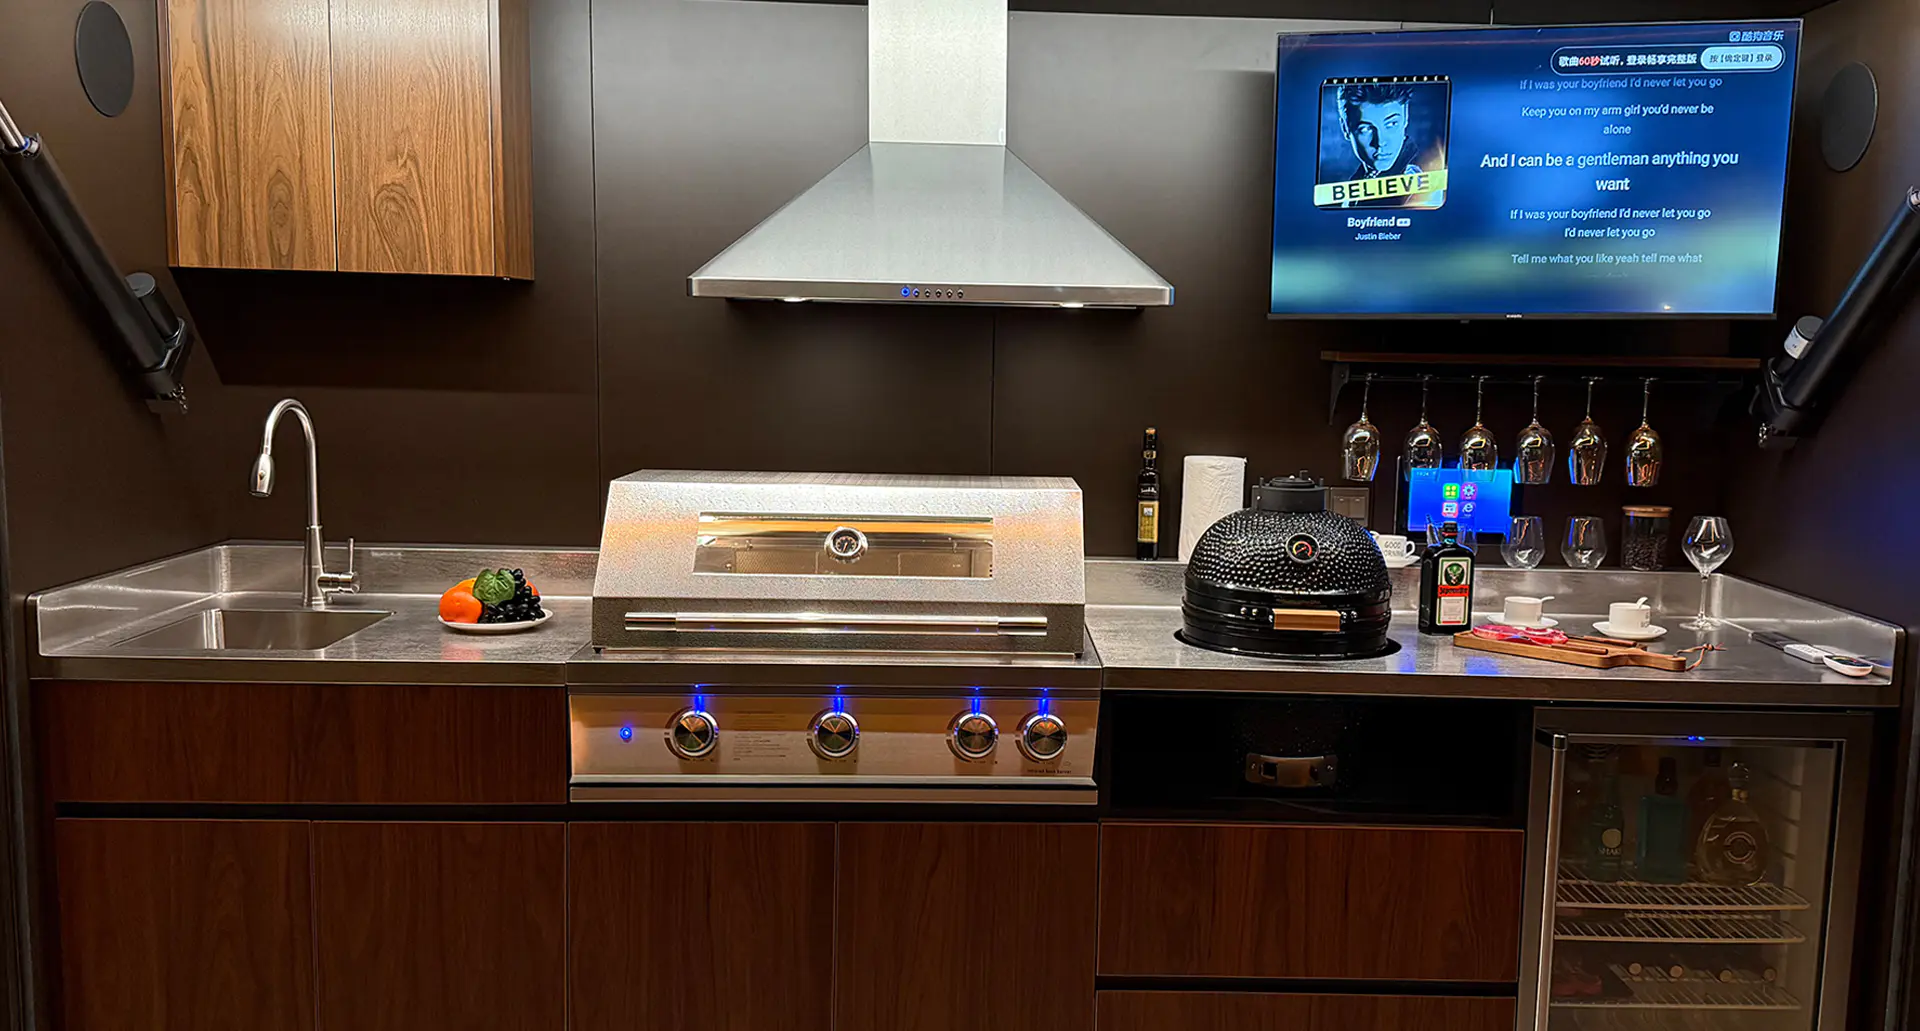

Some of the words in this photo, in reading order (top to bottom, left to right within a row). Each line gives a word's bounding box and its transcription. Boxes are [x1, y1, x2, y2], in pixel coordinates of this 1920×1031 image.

[1520, 80, 1527, 90] If
[1529, 80, 1533, 89] I
[1534, 81, 1555, 90] was
[1557, 80, 1579, 92] your
[1581, 78, 1628, 91] boyfriend
[1630, 77, 1641, 88] I'd
[1643, 79, 1671, 88] never
[1673, 77, 1686, 88] let
[1688, 78, 1706, 90] you
[1708, 78, 1723, 89] go
[1521, 106, 1547, 119] Keep
[1548, 107, 1567, 119] you
[1569, 107, 1582, 116] on
[1584, 106, 1600, 118] my
[1602, 106, 1622, 115] arm
[1624, 104, 1640, 117] girl
[1642, 104, 1669, 117] you'd
[1670, 105, 1699, 115] never
[1701, 103, 1714, 114] be
[1603, 124, 1632, 134] alone
[1480, 153, 1508, 168] And
[1511, 154, 1515, 167] I
[1518, 155, 1542, 167] can
[1545, 153, 1563, 166] be
[1565, 156, 1575, 166] a
[1577, 152, 1649, 168] gentleman
[1652, 151, 1710, 168] anything
[1712, 153, 1739, 167] you
[1332, 174, 1430, 201] BELIEVE
[1596, 178, 1631, 191] want
[1510, 209, 1517, 219] If
[1519, 210, 1523, 219] I
[1525, 210, 1545, 219] was
[1547, 210, 1569, 221] your
[1571, 208, 1618, 221] boyfriend
[1619, 208, 1631, 218] I'd
[1632, 209, 1660, 218] never
[1662, 207, 1675, 218] let
[1676, 209, 1695, 220] you
[1697, 209, 1711, 220] go
[1347, 216, 1396, 229] Boyfriend
[1355, 232, 1378, 241] Justin
[1378, 232, 1402, 241] Bieber
[1564, 228, 1576, 238] I'd
[1578, 229, 1605, 237] never
[1607, 227, 1620, 237] let
[1621, 228, 1640, 239] you
[1642, 228, 1655, 239] go
[1511, 254, 1529, 264] Tell
[1531, 255, 1547, 264] me
[1549, 253, 1574, 264] what
[1575, 255, 1593, 265] you
[1596, 253, 1613, 263] like
[1615, 253, 1640, 265] yeah
[1641, 253, 1657, 263] tell
[1659, 254, 1676, 263] me
[1677, 253, 1703, 263] what
[1384, 541, 1401, 549] GOOD
